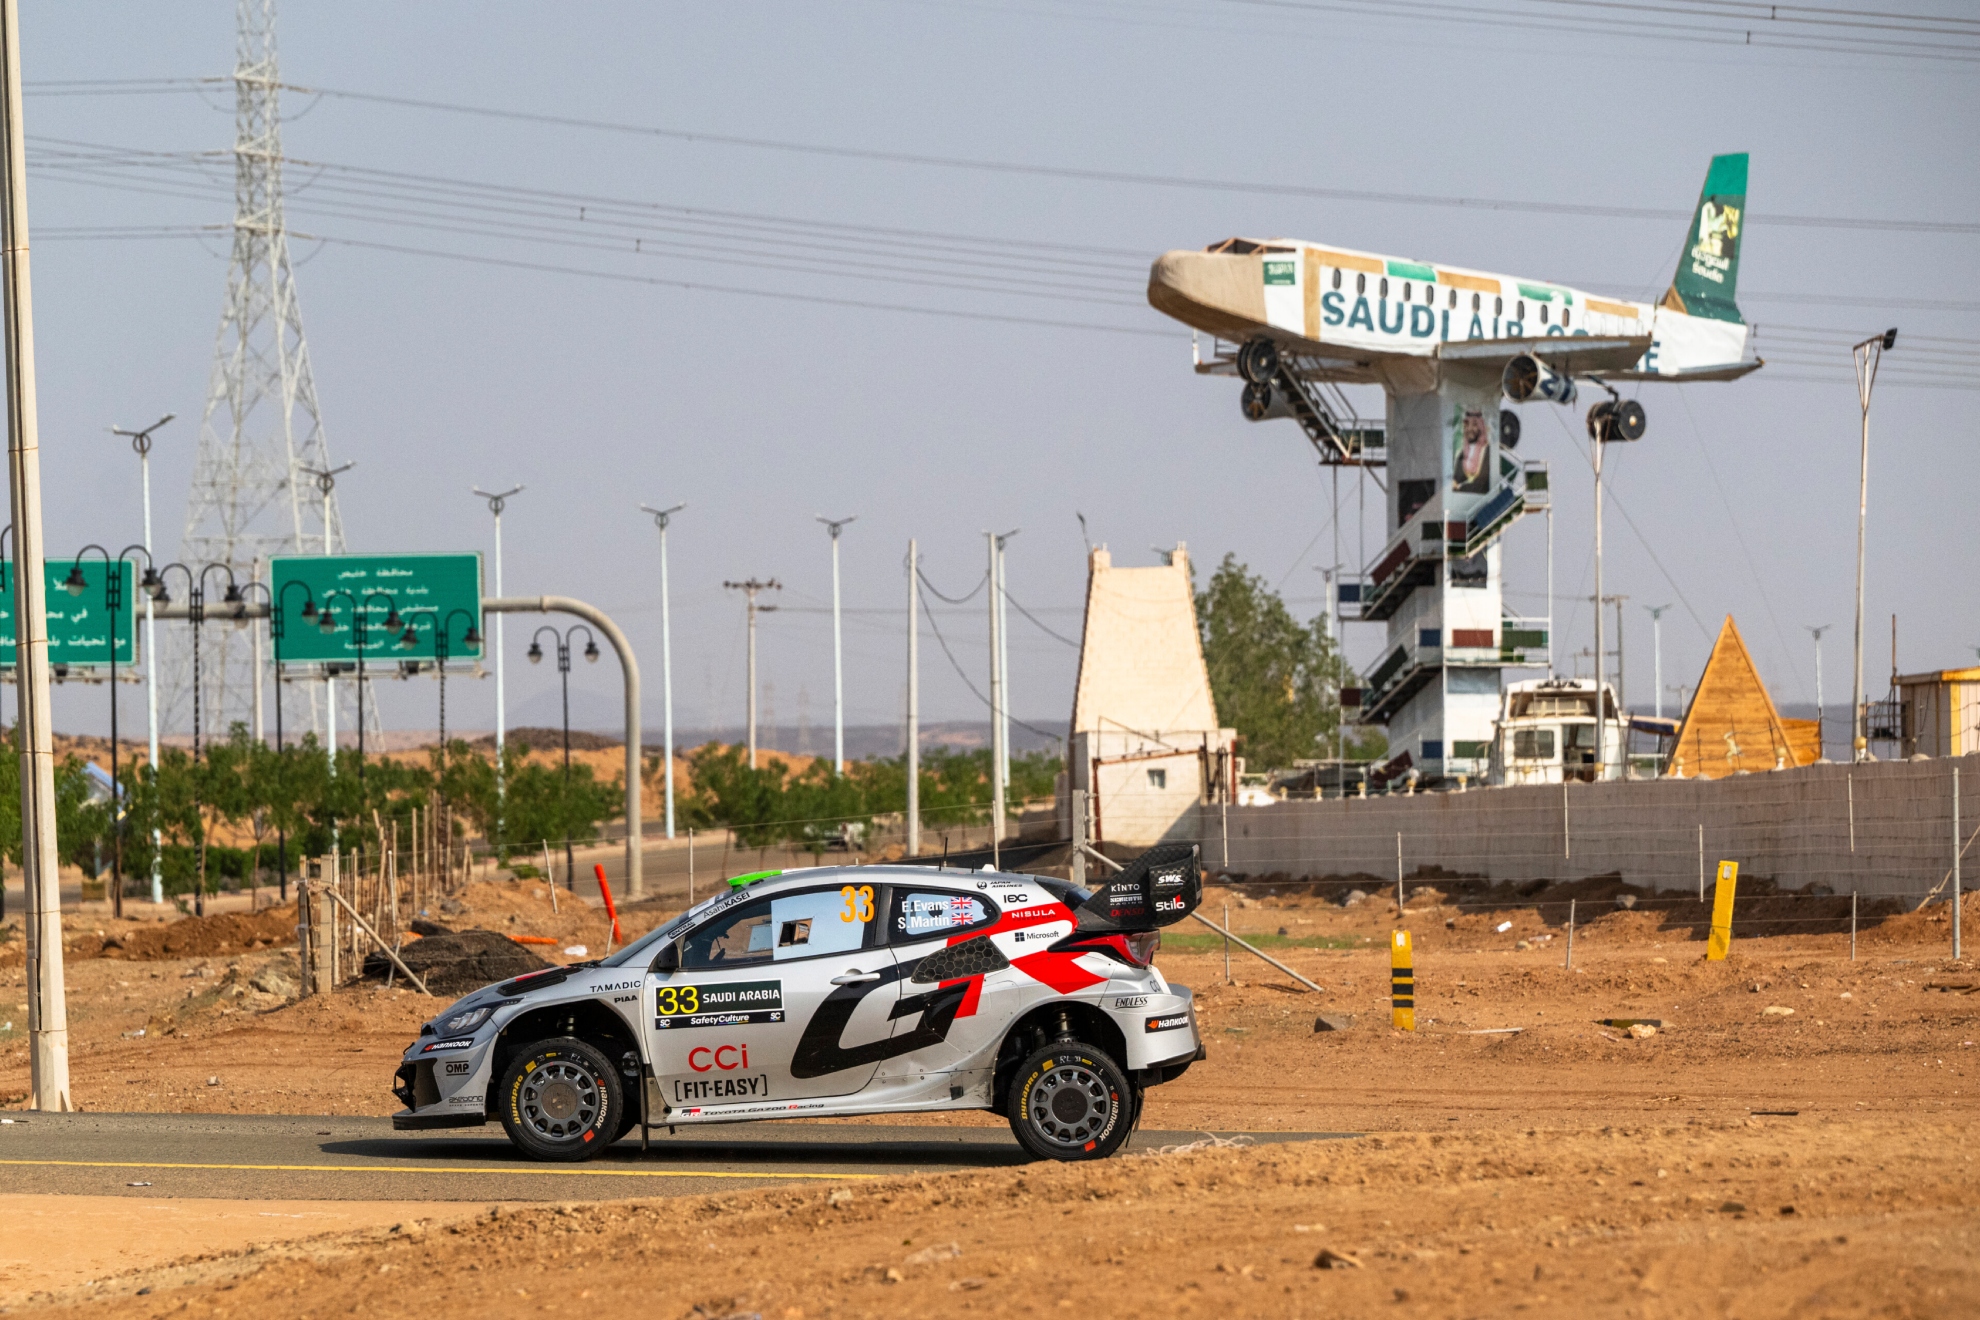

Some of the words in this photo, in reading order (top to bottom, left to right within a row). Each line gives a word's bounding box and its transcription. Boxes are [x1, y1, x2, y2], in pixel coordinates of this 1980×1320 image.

[1321, 291, 1451, 342] SAUDI
[840, 885, 875, 923] 33
[1011, 909, 1056, 919] NISULA
[897, 914, 950, 930] S.Martin
[1026, 931, 1060, 940] Microsoft
[590, 980, 641, 993] TAMADIC
[614, 995, 638, 1003] PIAA
[659, 986, 699, 1015] 33
[702, 992, 736, 1004] SAUDI
[738, 989, 780, 1001] ARABIA
[446, 1063, 470, 1073] OMP
